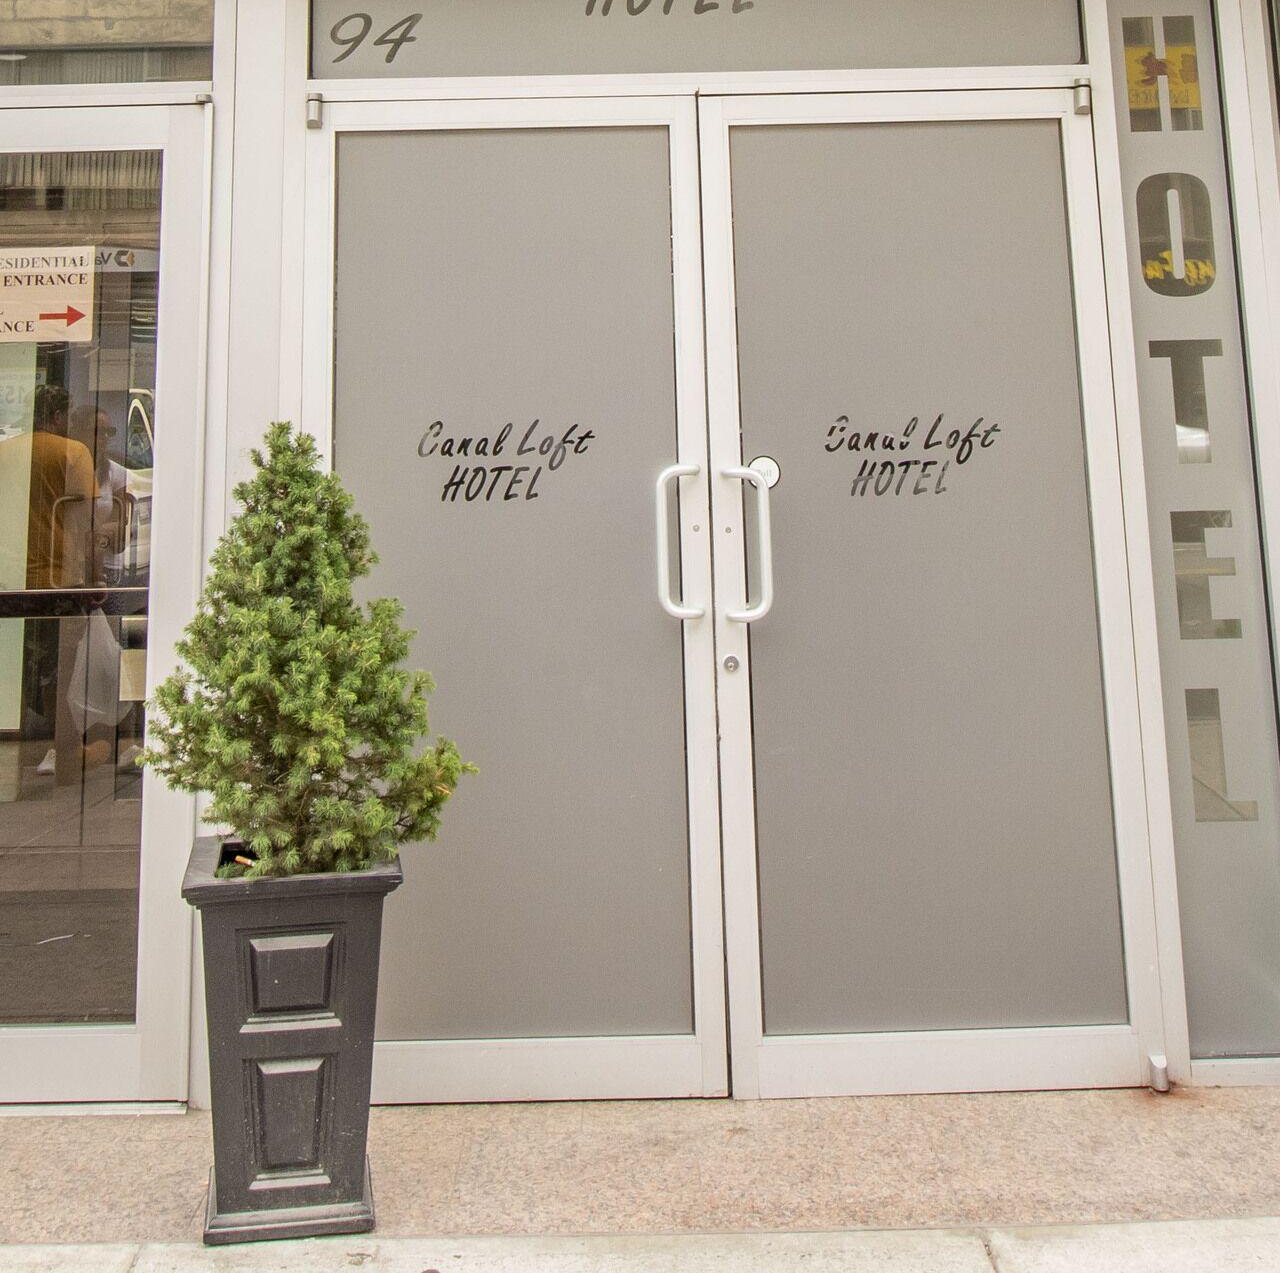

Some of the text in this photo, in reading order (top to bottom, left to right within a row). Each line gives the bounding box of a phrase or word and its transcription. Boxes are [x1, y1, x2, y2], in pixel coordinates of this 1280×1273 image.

[330, 13, 423, 63] 94
[3, 273, 88, 287] ENTRANCE
[824, 413, 1001, 464] Canal Loft
[1121, 15, 1259, 822] HOTEL
[417, 419, 595, 470] Canal Loft
[441, 464, 542, 502] HOTEL
[850, 459, 950, 497] HOTEL
